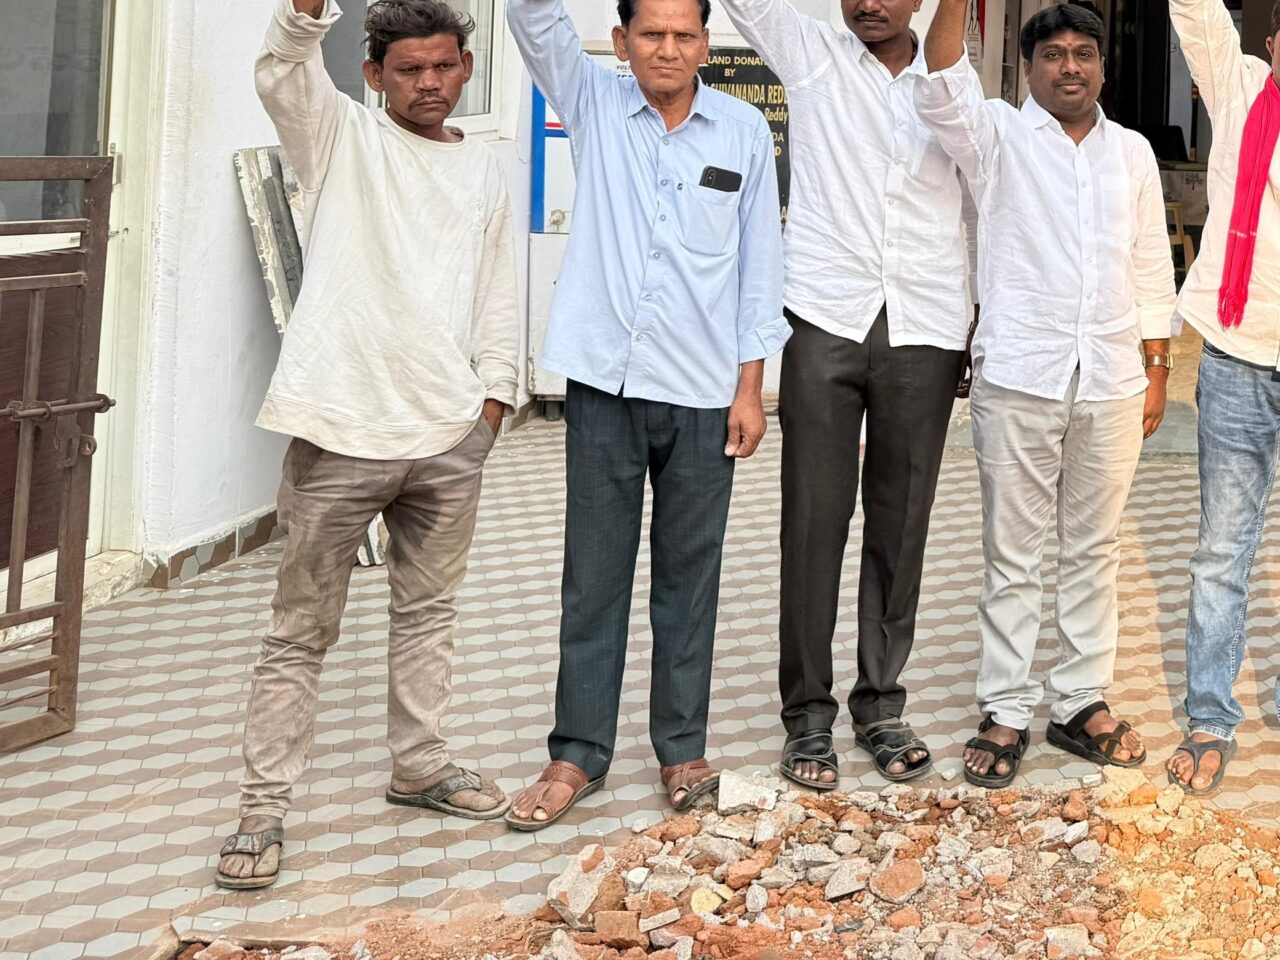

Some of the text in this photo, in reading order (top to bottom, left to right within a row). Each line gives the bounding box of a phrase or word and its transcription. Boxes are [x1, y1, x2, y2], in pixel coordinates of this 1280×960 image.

[708, 56, 767, 65] LAND DONAT
[724, 68, 736, 77] BY
[765, 107, 788, 126] Reddy
